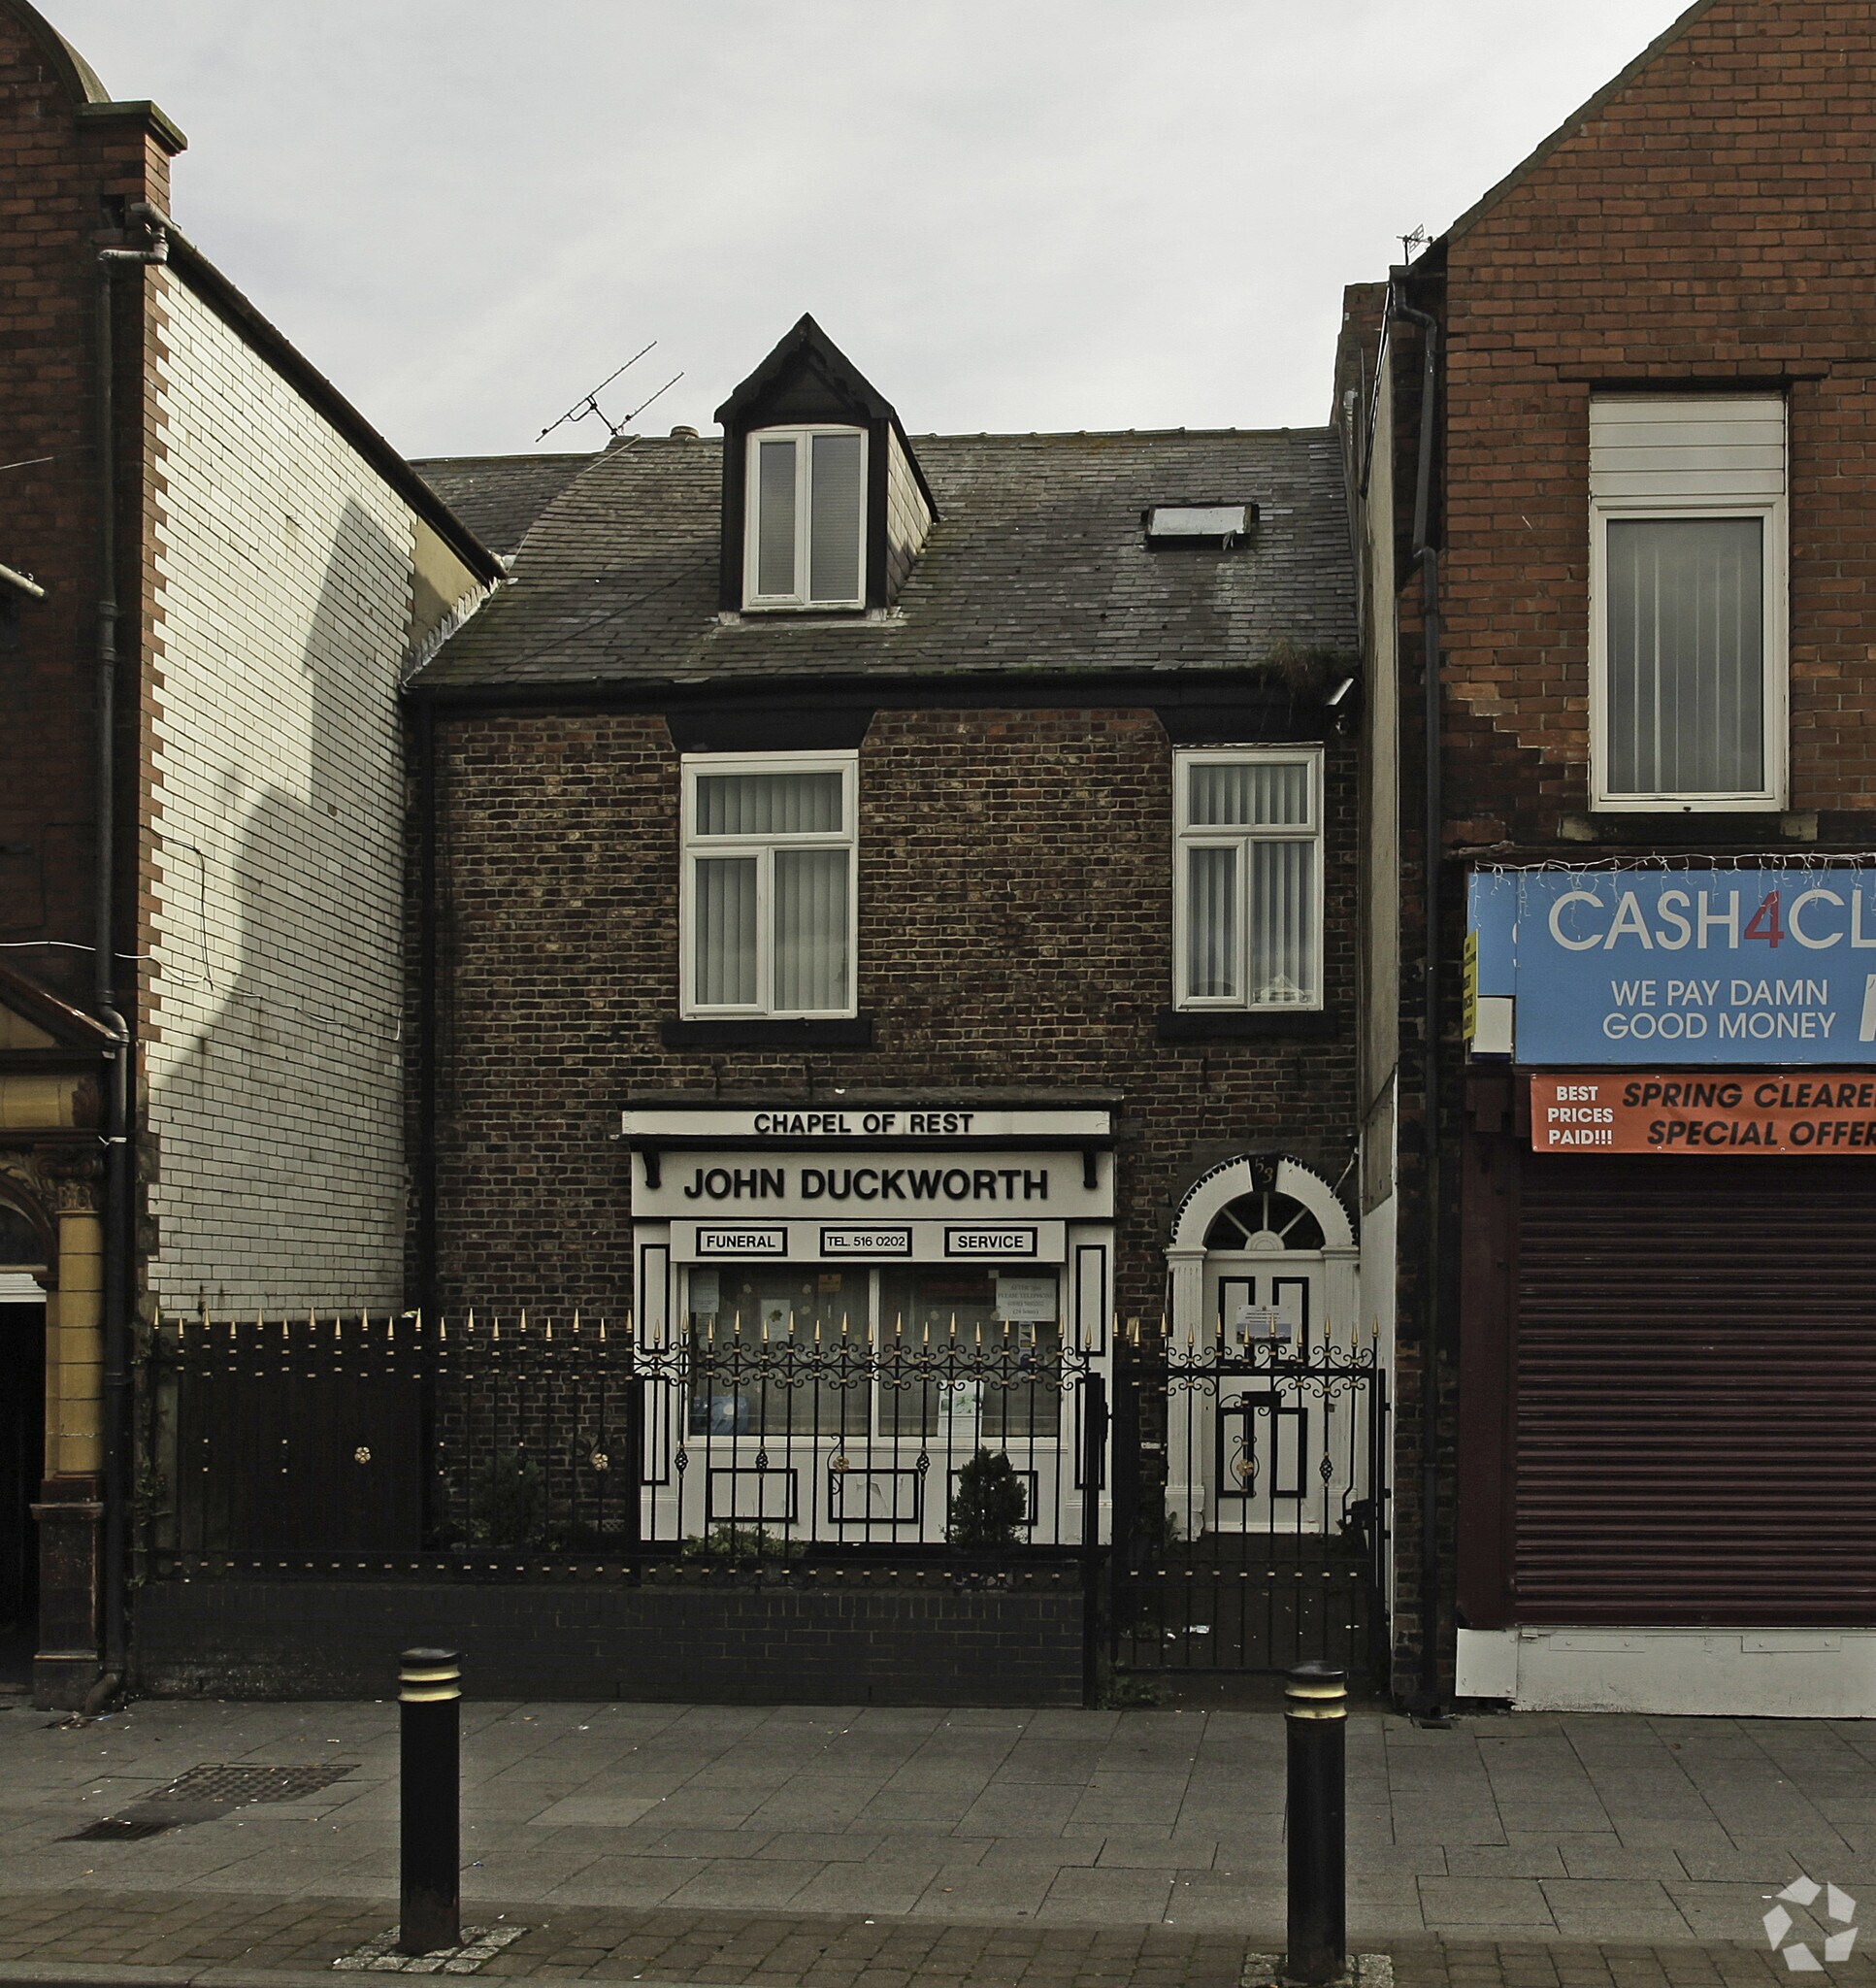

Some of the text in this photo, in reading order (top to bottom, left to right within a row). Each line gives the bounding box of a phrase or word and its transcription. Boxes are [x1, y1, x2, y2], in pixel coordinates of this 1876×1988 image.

[1549, 889, 1876, 950] CASH4CL
[1611, 979, 1827, 1006] WE PAY DAMN
[1602, 1012, 1836, 1039] GOOD MONEY
[1556, 1086, 1598, 1101] BEST
[1623, 1082, 1876, 1108] SPRING CLEARE
[754, 1113, 974, 1134] CHAPEL OF REST
[1547, 1108, 1614, 1123] PRICES
[1548, 1130, 1613, 1144] PAID!!!
[1648, 1120, 1778, 1146] SPECIAL
[684, 1168, 1048, 1201] JOHN DUCKWORTH
[707, 1235, 776, 1248] FUNERAL
[827, 1236, 905, 1247] TEL. 516 0202
[957, 1235, 1024, 1249] SERVICE
